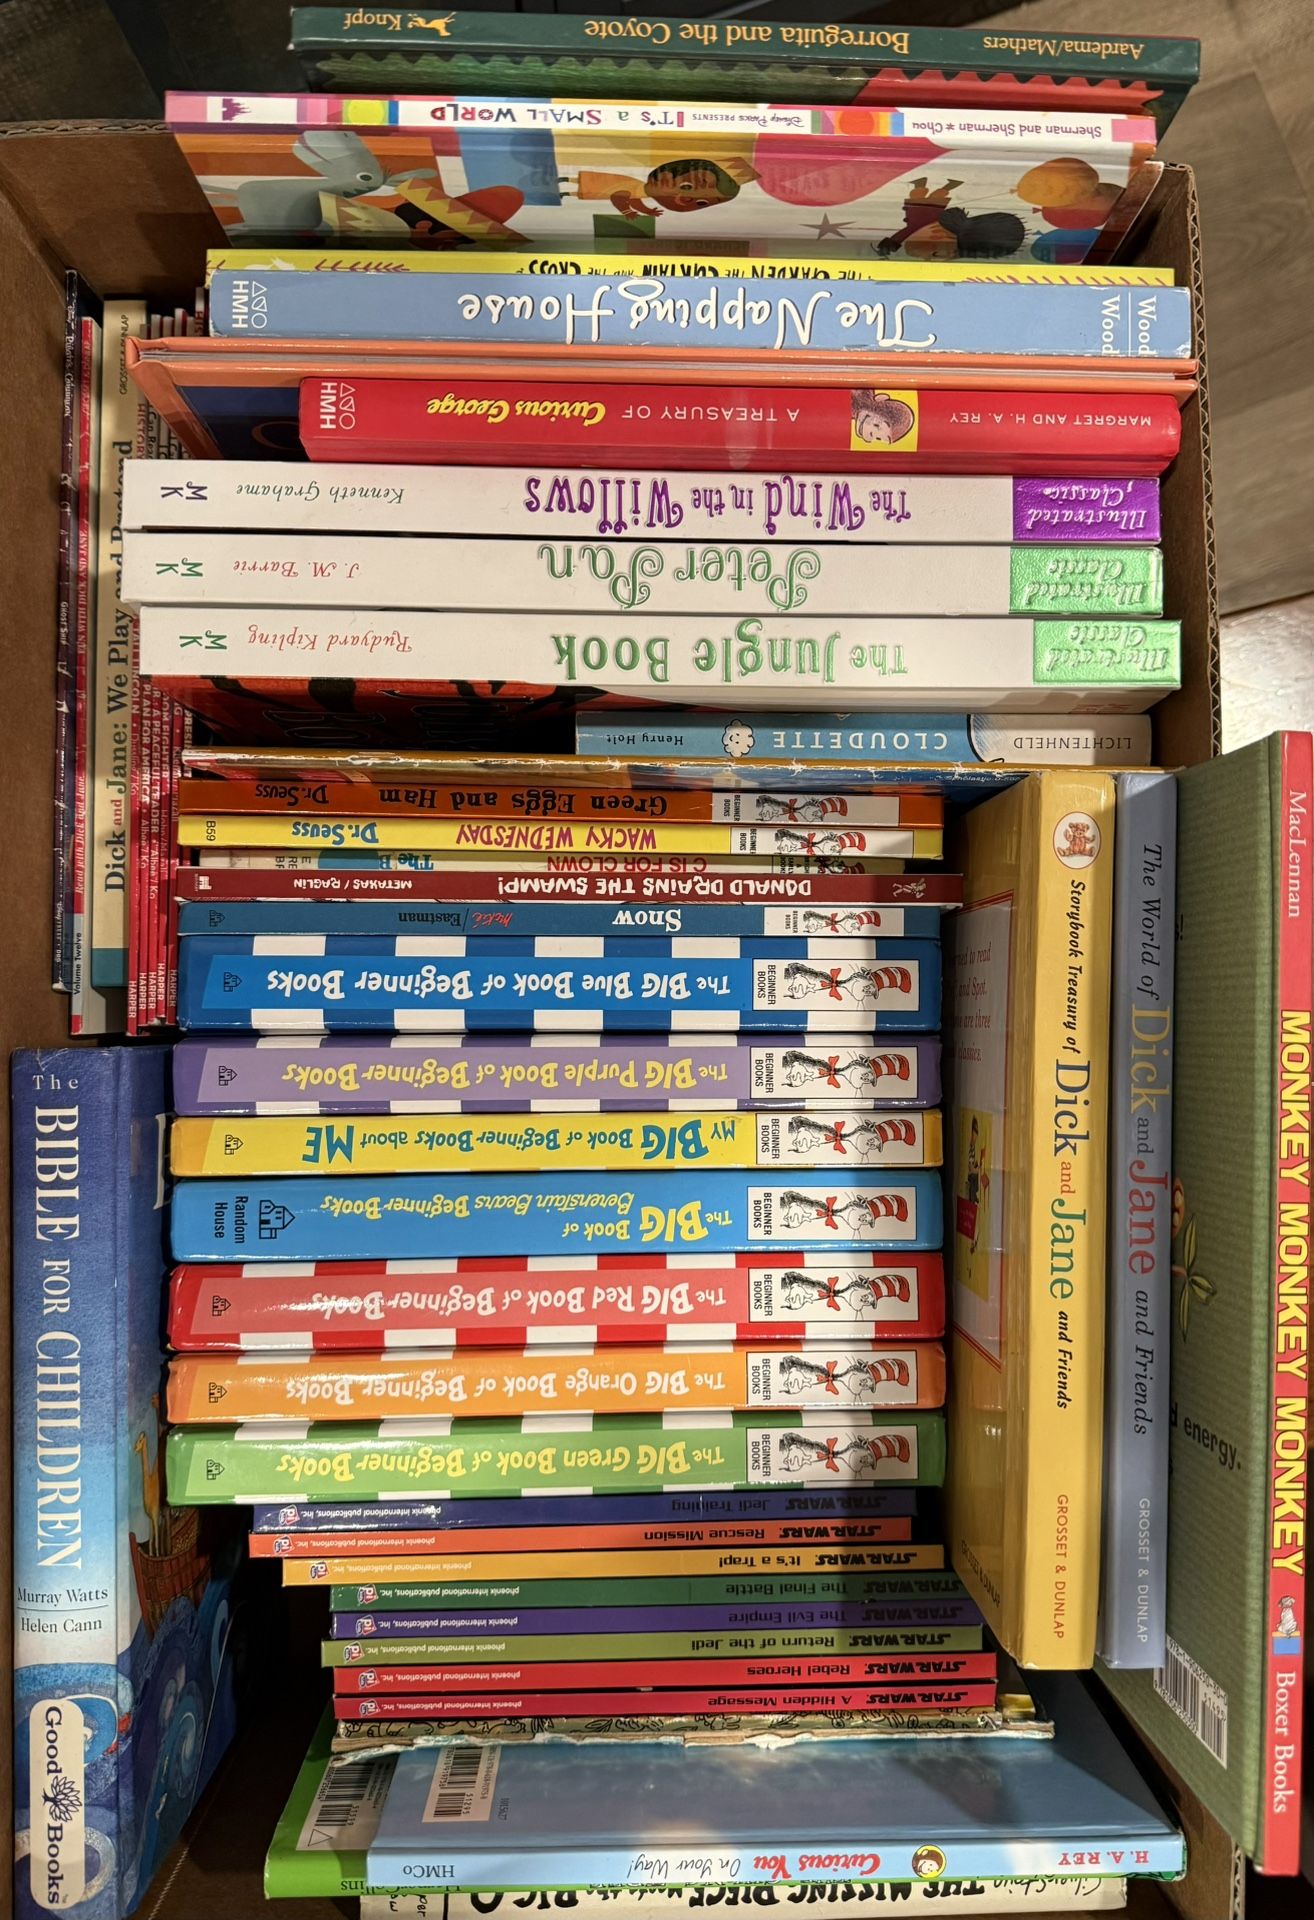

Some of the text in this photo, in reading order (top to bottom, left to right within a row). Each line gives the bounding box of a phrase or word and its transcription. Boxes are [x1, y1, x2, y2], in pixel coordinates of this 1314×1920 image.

[343, 8, 402, 30] Knopf
[584, 18, 910, 53] Borreguita and the Coyote
[982, 36, 1144, 60] Aardema/Mathers
[430, 103, 629, 125] a SMALL WORLD
[692, 113, 735, 123] PRESENTS
[912, 122, 1102, 137] Sherman and Sherman Chou
[232, 280, 248, 328] HMH
[458, 279, 936, 349] The Napping House
[319, 382, 336, 430] HMH
[426, 392, 606, 427] Curious George
[621, 404, 799, 422] A TREASURY OF
[950, 412, 1151, 427] MARGRET AND H. A. REY
[235, 481, 404, 504] Kenneth Grahame
[524, 476, 912, 536] The Wind in the Willows
[1027, 508, 1147, 530] Illustrated
[233, 559, 360, 579] J. M. Barrie
[538, 544, 821, 612] Peter Pan
[248, 624, 412, 653] Rudyard Kipling
[551, 618, 907, 683] The Jungle Book
[104, 608, 132, 892] Dick and Jane: We Play
[606, 732, 684, 746] Henry Holt
[771, 730, 948, 750] CLOUDETTE
[1013, 736, 1132, 750] LICHTENHELD
[256, 784, 329, 805] Dr. Seuss
[378, 788, 668, 816] Green Eggs and Ham
[206, 820, 216, 841] B59
[292, 822, 379, 845] Dr. Seuss
[456, 824, 654, 852] WACKY WEDNESDAY
[1288, 790, 1306, 918] MacLennan
[353, 878, 412, 889] METAXAS
[498, 876, 811, 896] DONALD THE SWAMP!
[398, 911, 462, 927] Eastman
[612, 908, 682, 932] Snow
[74, 932, 82, 995] Volume Twelve
[267, 965, 730, 1000] The BIG Blue Book of Beginner Books
[757, 970, 765, 998] BOOKS
[768, 964, 776, 1005] BEGINNER
[33, 1074, 79, 1090] The
[1050, 879, 1090, 1409] Storybook Treasury of Dick and Jane and Friends
[1128, 844, 1170, 1434] The World of Dick and Jane and Friends
[320, 1192, 634, 1220] Berenstain Bears Beginner Books
[214, 1202, 228, 1238] House
[234, 1196, 248, 1244] Random
[562, 1200, 732, 1242] The BIG Book of
[1271, 1010, 1312, 1576] MONKEY MONKEY MONKEY
[35, 1106, 82, 1569] BIBLE FOR CHILDREN
[1184, 1417, 1242, 1472] energy.
[1054, 1494, 1068, 1639] GROSSET & DUNLAP
[16, 1586, 109, 1606] Murray Watts
[20, 1617, 102, 1634] Helen Cann
[366, 1642, 505, 1654] phoenix international publications, inc.
[690, 1636, 834, 1650] Return of the Jedi
[850, 1633, 951, 1647] STAR WARS
[747, 1664, 850, 1678] Rebel Heroes
[866, 1660, 967, 1674] STAR WARS
[1272, 1671, 1296, 1814] Boxer Books
[45, 1706, 64, 1905] Good Books
[402, 1864, 455, 1878] HMCo
[626, 1857, 741, 1878] On Your Way!
[753, 1852, 880, 1880] Curious You
